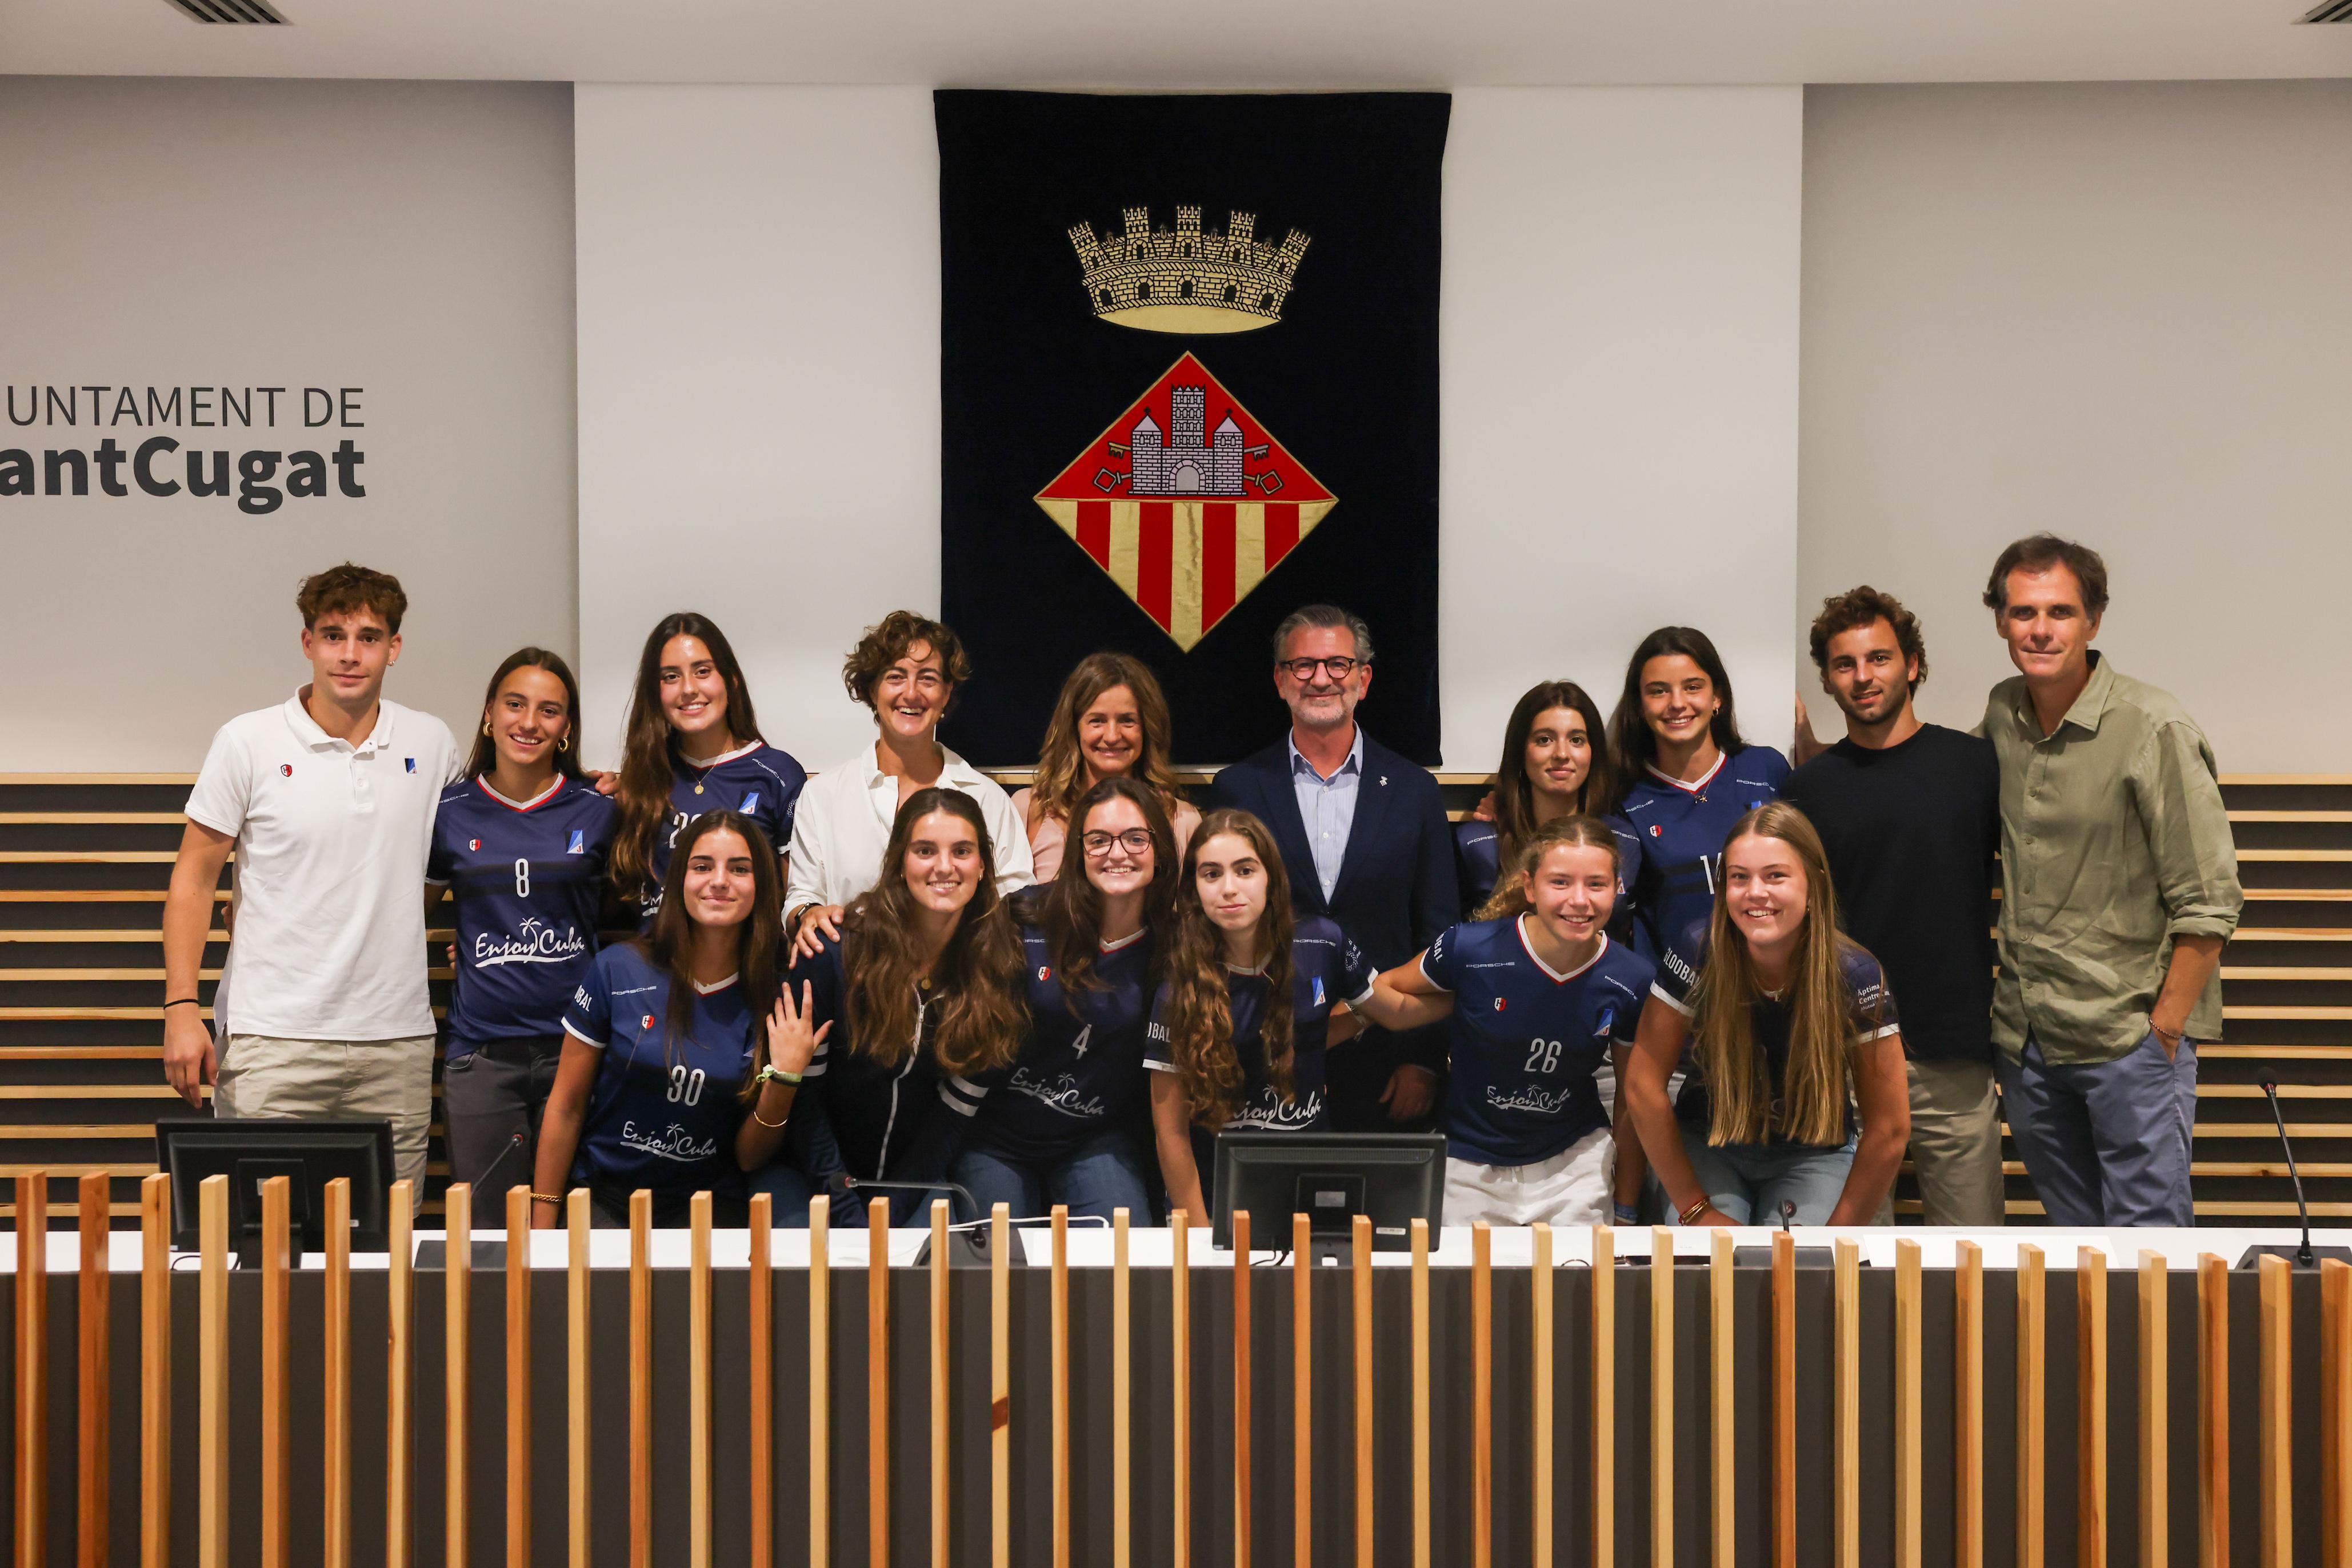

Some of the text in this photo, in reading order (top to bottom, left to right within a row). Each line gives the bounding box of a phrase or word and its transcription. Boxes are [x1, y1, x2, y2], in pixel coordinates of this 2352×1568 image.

[303, 388, 365, 427] DE
[515, 858, 530, 898] 8
[475, 926, 586, 966] Enjoy Cuba
[1293, 939, 1336, 947] PORSCHE
[611, 985, 657, 995] PORSCHE
[1072, 1023, 1092, 1059] 4
[1524, 1038, 1562, 1073] 26
[667, 1065, 706, 1106] 30
[1010, 1067, 1105, 1115] Enjoy Cuba
[1278, 1091, 1321, 1121] Cuba
[623, 1121, 678, 1157] Enjoy
